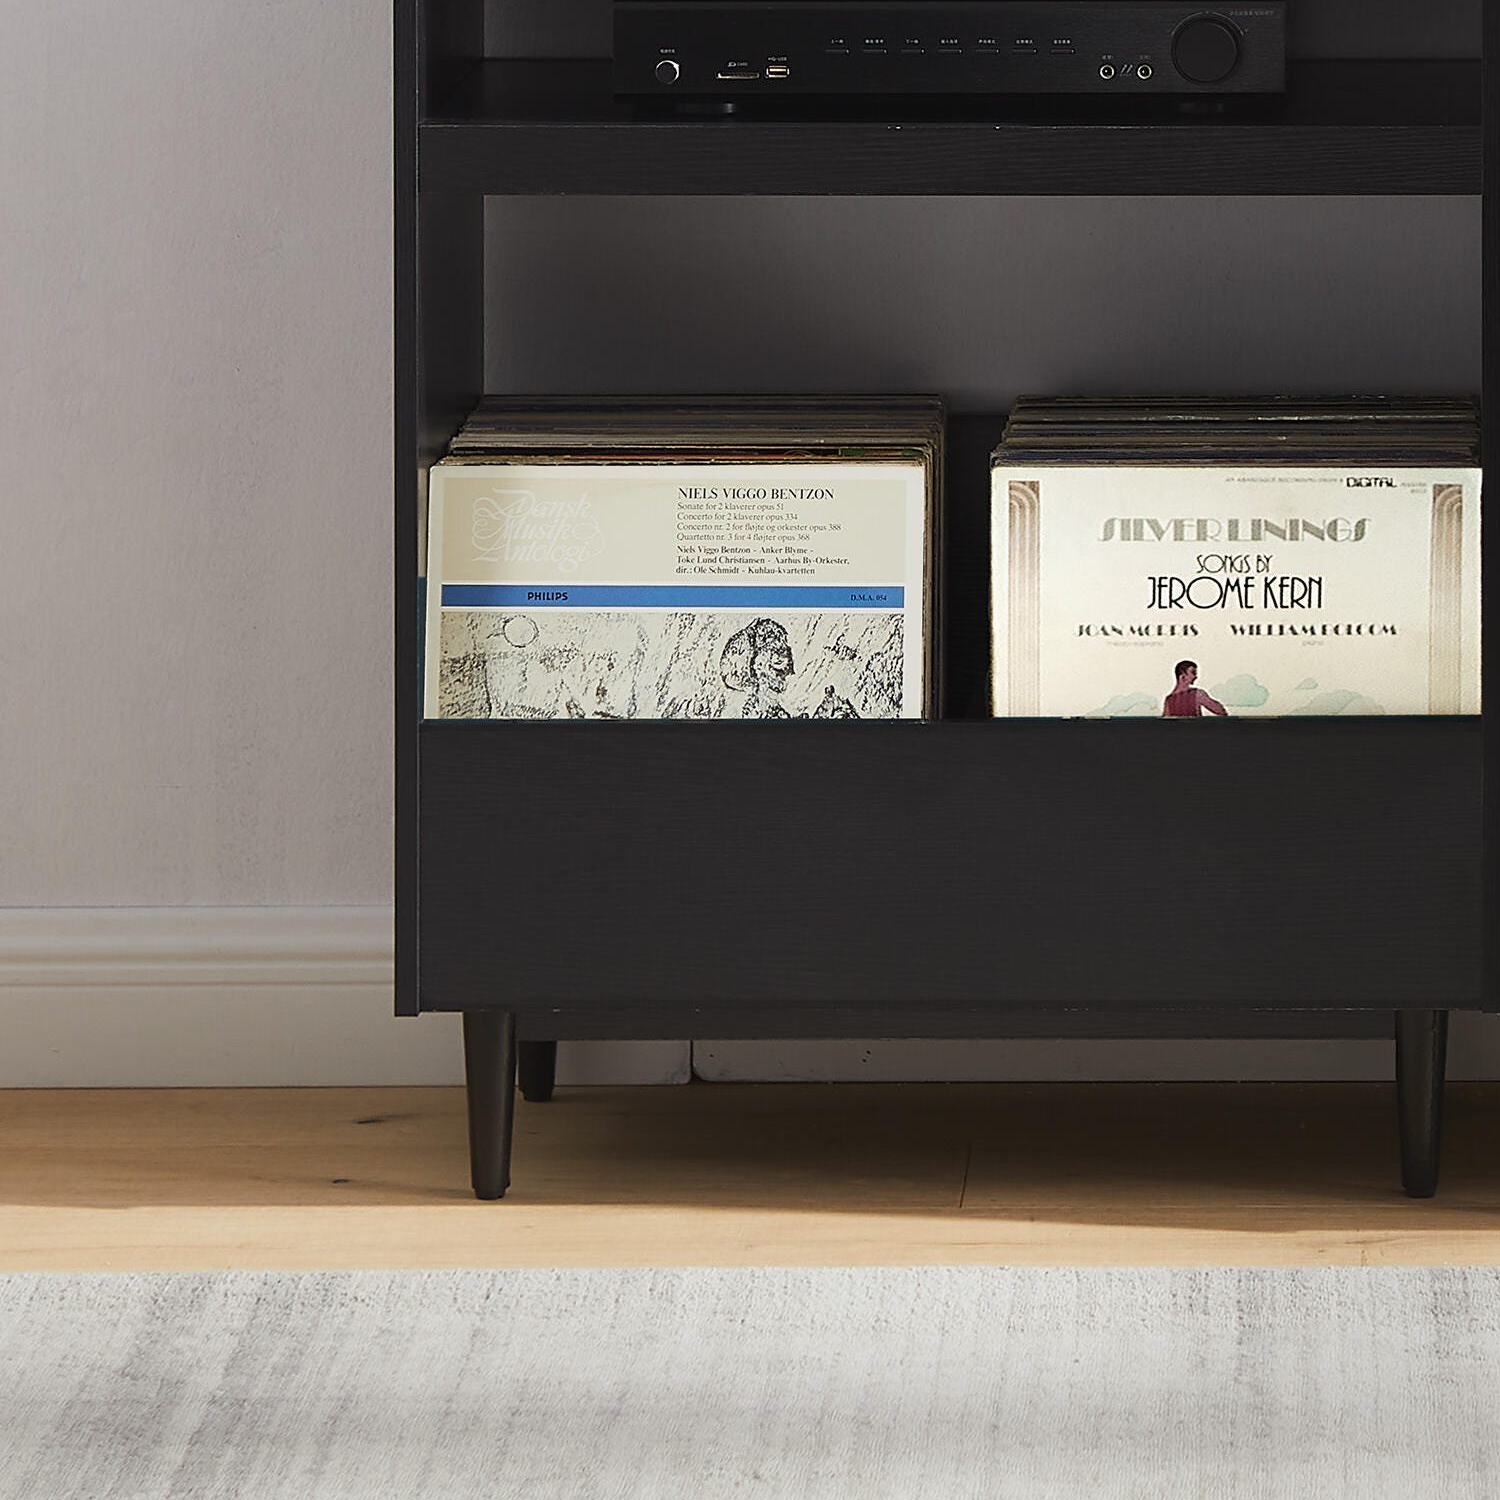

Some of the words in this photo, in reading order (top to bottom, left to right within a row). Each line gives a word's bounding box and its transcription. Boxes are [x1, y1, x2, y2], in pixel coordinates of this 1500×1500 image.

[679, 488, 718, 499] NIELS
[723, 488, 766, 499] VIGGO
[771, 488, 834, 499] BENTZON
[766, 514, 783, 522] opus
[1098, 518, 1222, 542] SILVER
[1227, 518, 1372, 542] LININGS
[677, 533, 714, 541] Quartetto
[734, 533, 745, 541] for
[698, 546, 719, 555] Viggo
[677, 556, 695, 564] Toke
[697, 556, 716, 564] Lund
[719, 556, 765, 564] Christiansen
[774, 556, 800, 564] Aarhus
[1197, 554, 1251, 573] SONGS
[1256, 554, 1273, 573] BY
[527, 592, 568, 601] PHILIPS
[1147, 576, 1255, 609] JEROME
[1264, 576, 1323, 609] KERN
[1075, 624, 1123, 636] JOAN
[1130, 624, 1200, 636] MORRIS
[1230, 624, 1315, 635] WILLIAM
